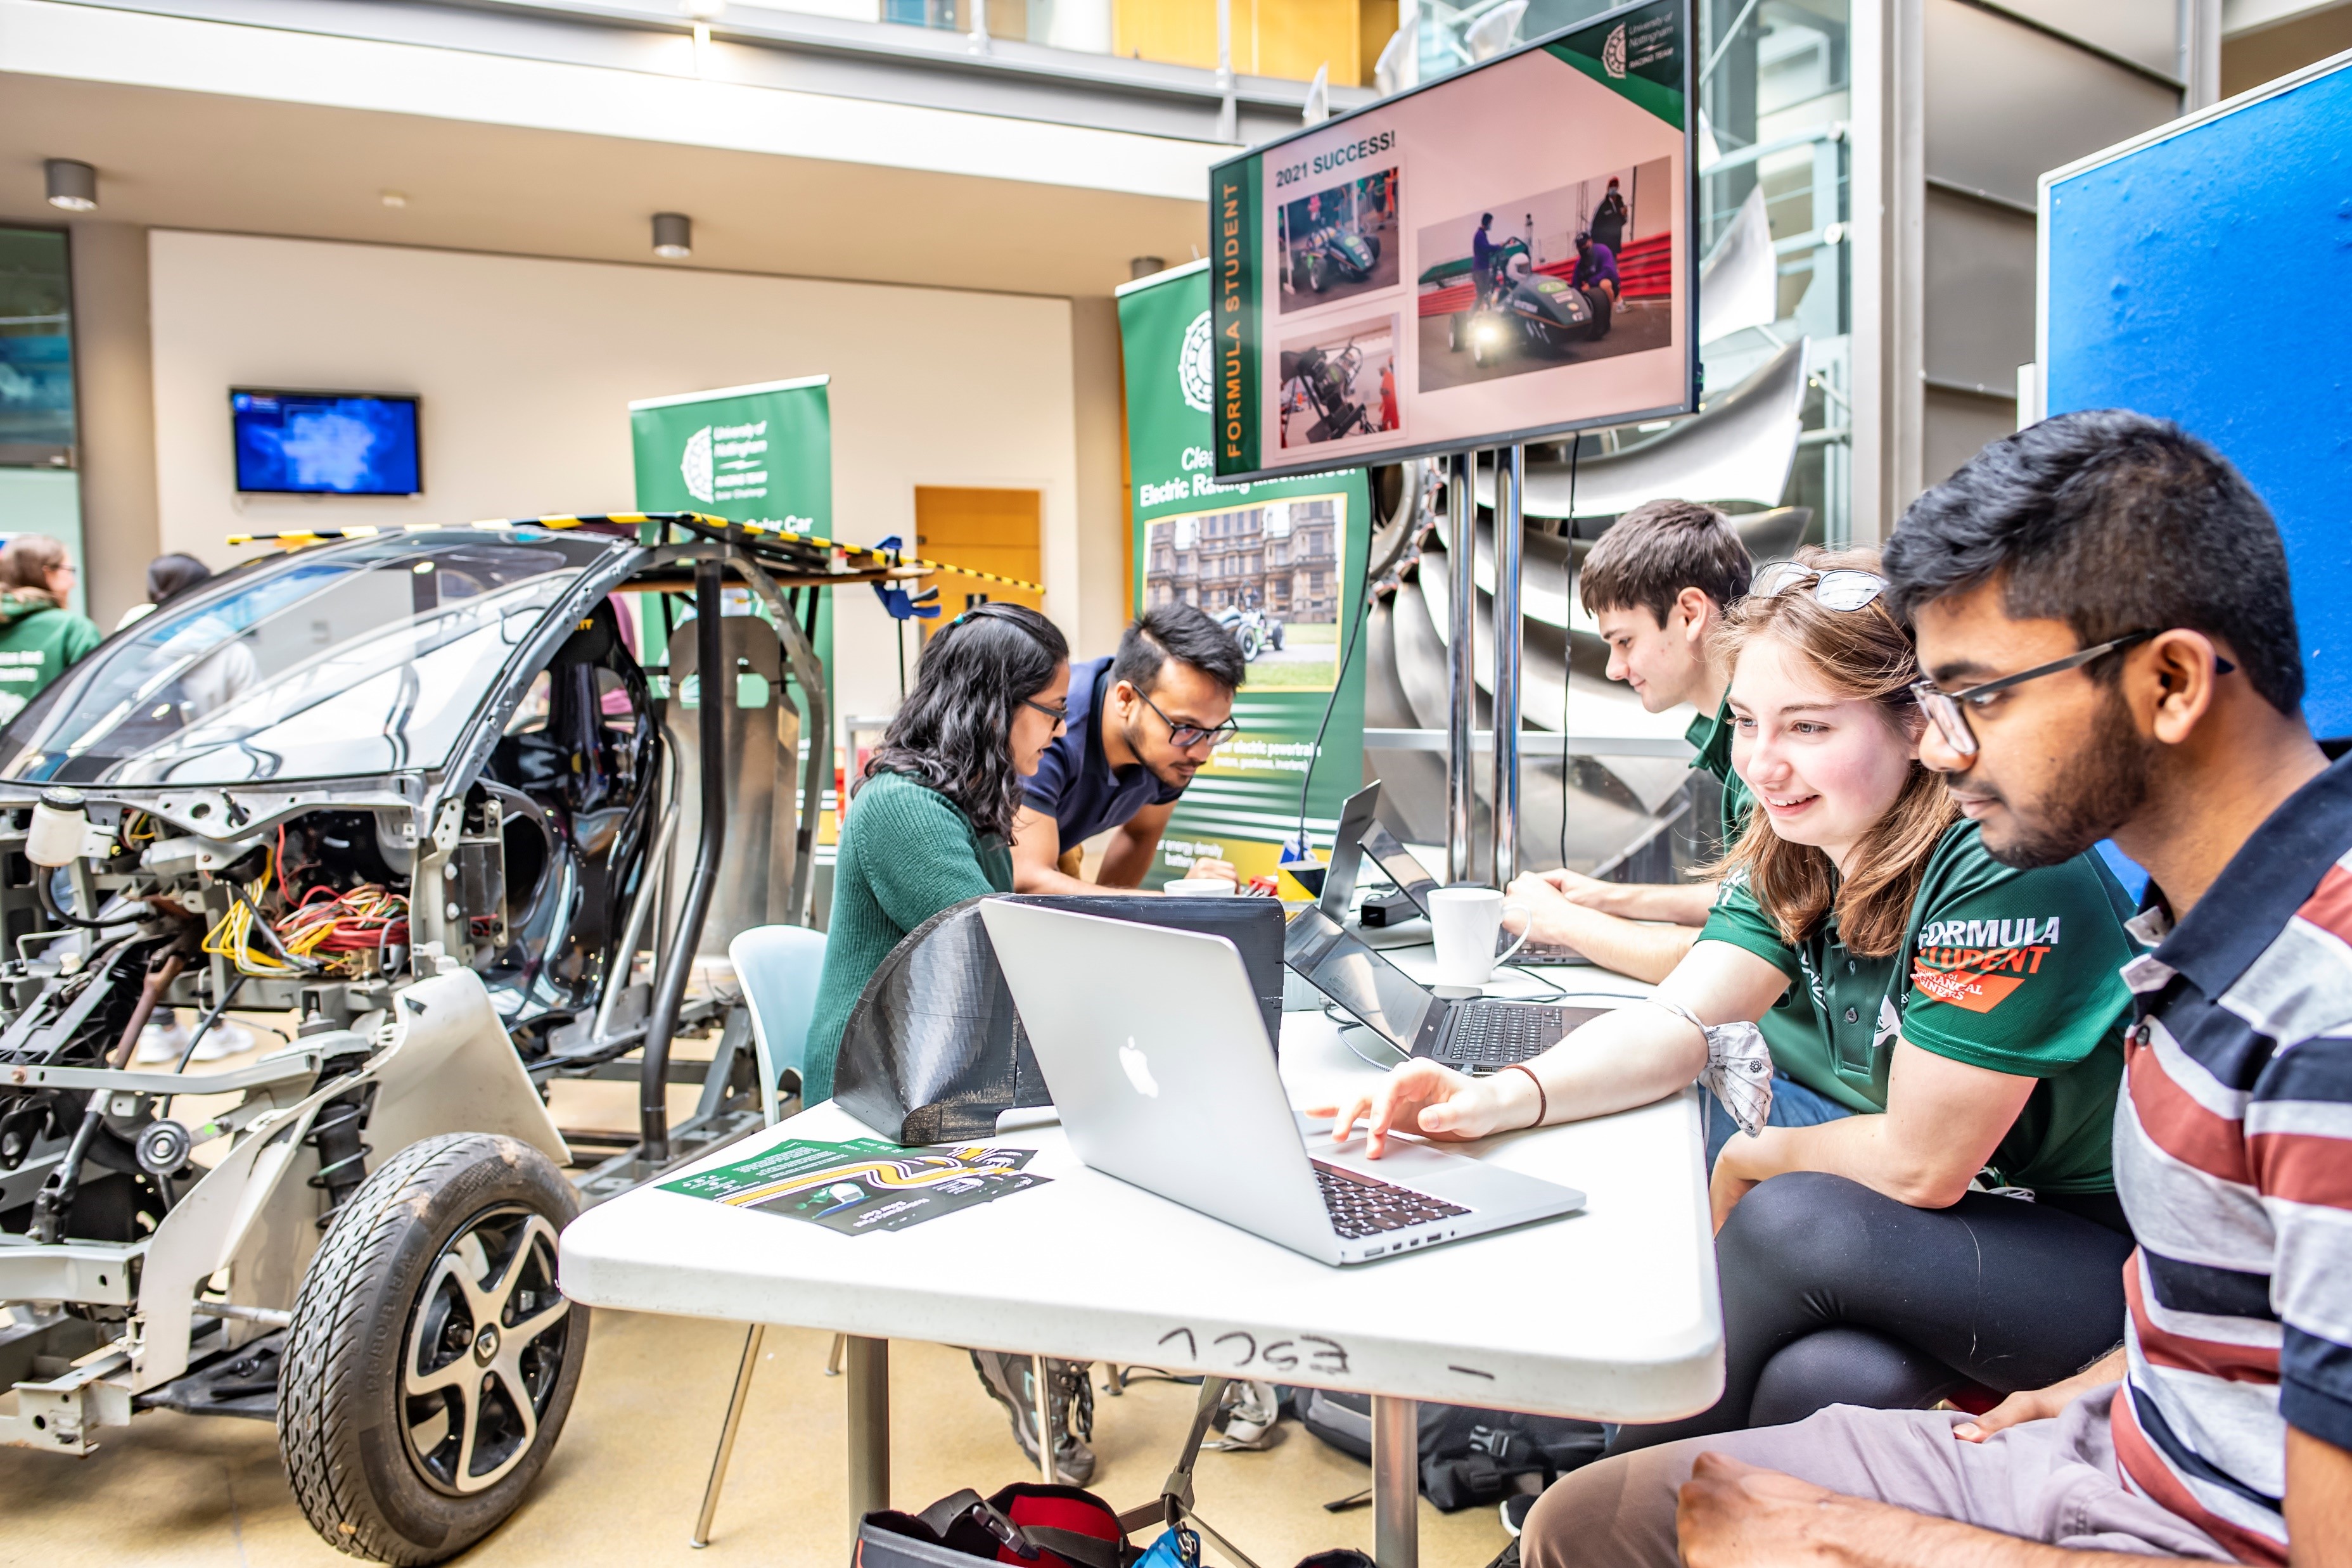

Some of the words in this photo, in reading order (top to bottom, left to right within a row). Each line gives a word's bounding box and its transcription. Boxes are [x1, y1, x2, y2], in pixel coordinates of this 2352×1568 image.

[1276, 160, 1308, 188] 2021
[1313, 130, 1396, 174] SUCCESS!
[1224, 184, 1241, 312] STUDENT
[1226, 320, 1242, 457] FORMULA
[1140, 476, 1189, 507] Electric
[784, 514, 814, 533] Car
[1165, 839, 1193, 857] energy
[1918, 916, 2059, 950] FORMULA
